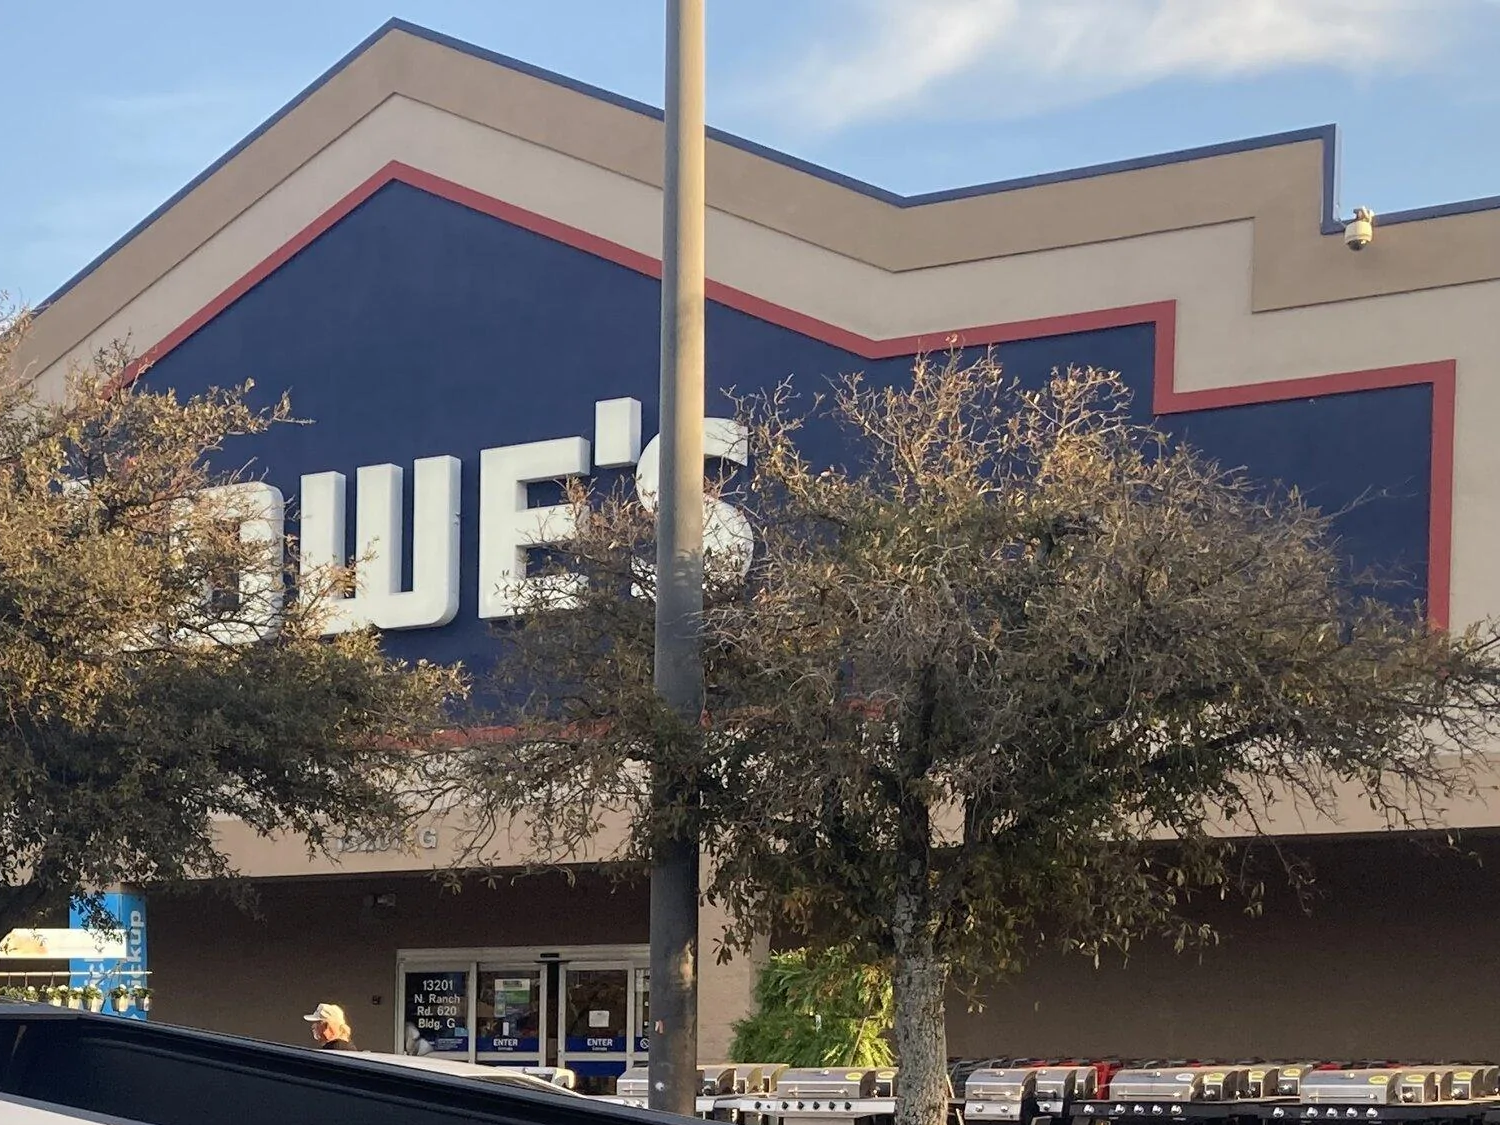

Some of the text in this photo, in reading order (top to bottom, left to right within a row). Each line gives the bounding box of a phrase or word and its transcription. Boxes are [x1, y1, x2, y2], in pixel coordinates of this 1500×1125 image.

[110, 397, 754, 652] OWE'S
[422, 979, 453, 991] 13201
[429, 992, 460, 1004] Ranch
[417, 1005, 457, 1016] Rd. 620
[418, 1017, 456, 1030] Bldg. G
[493, 1038, 518, 1047] ENTER
[586, 1038, 613, 1047] ENTER
